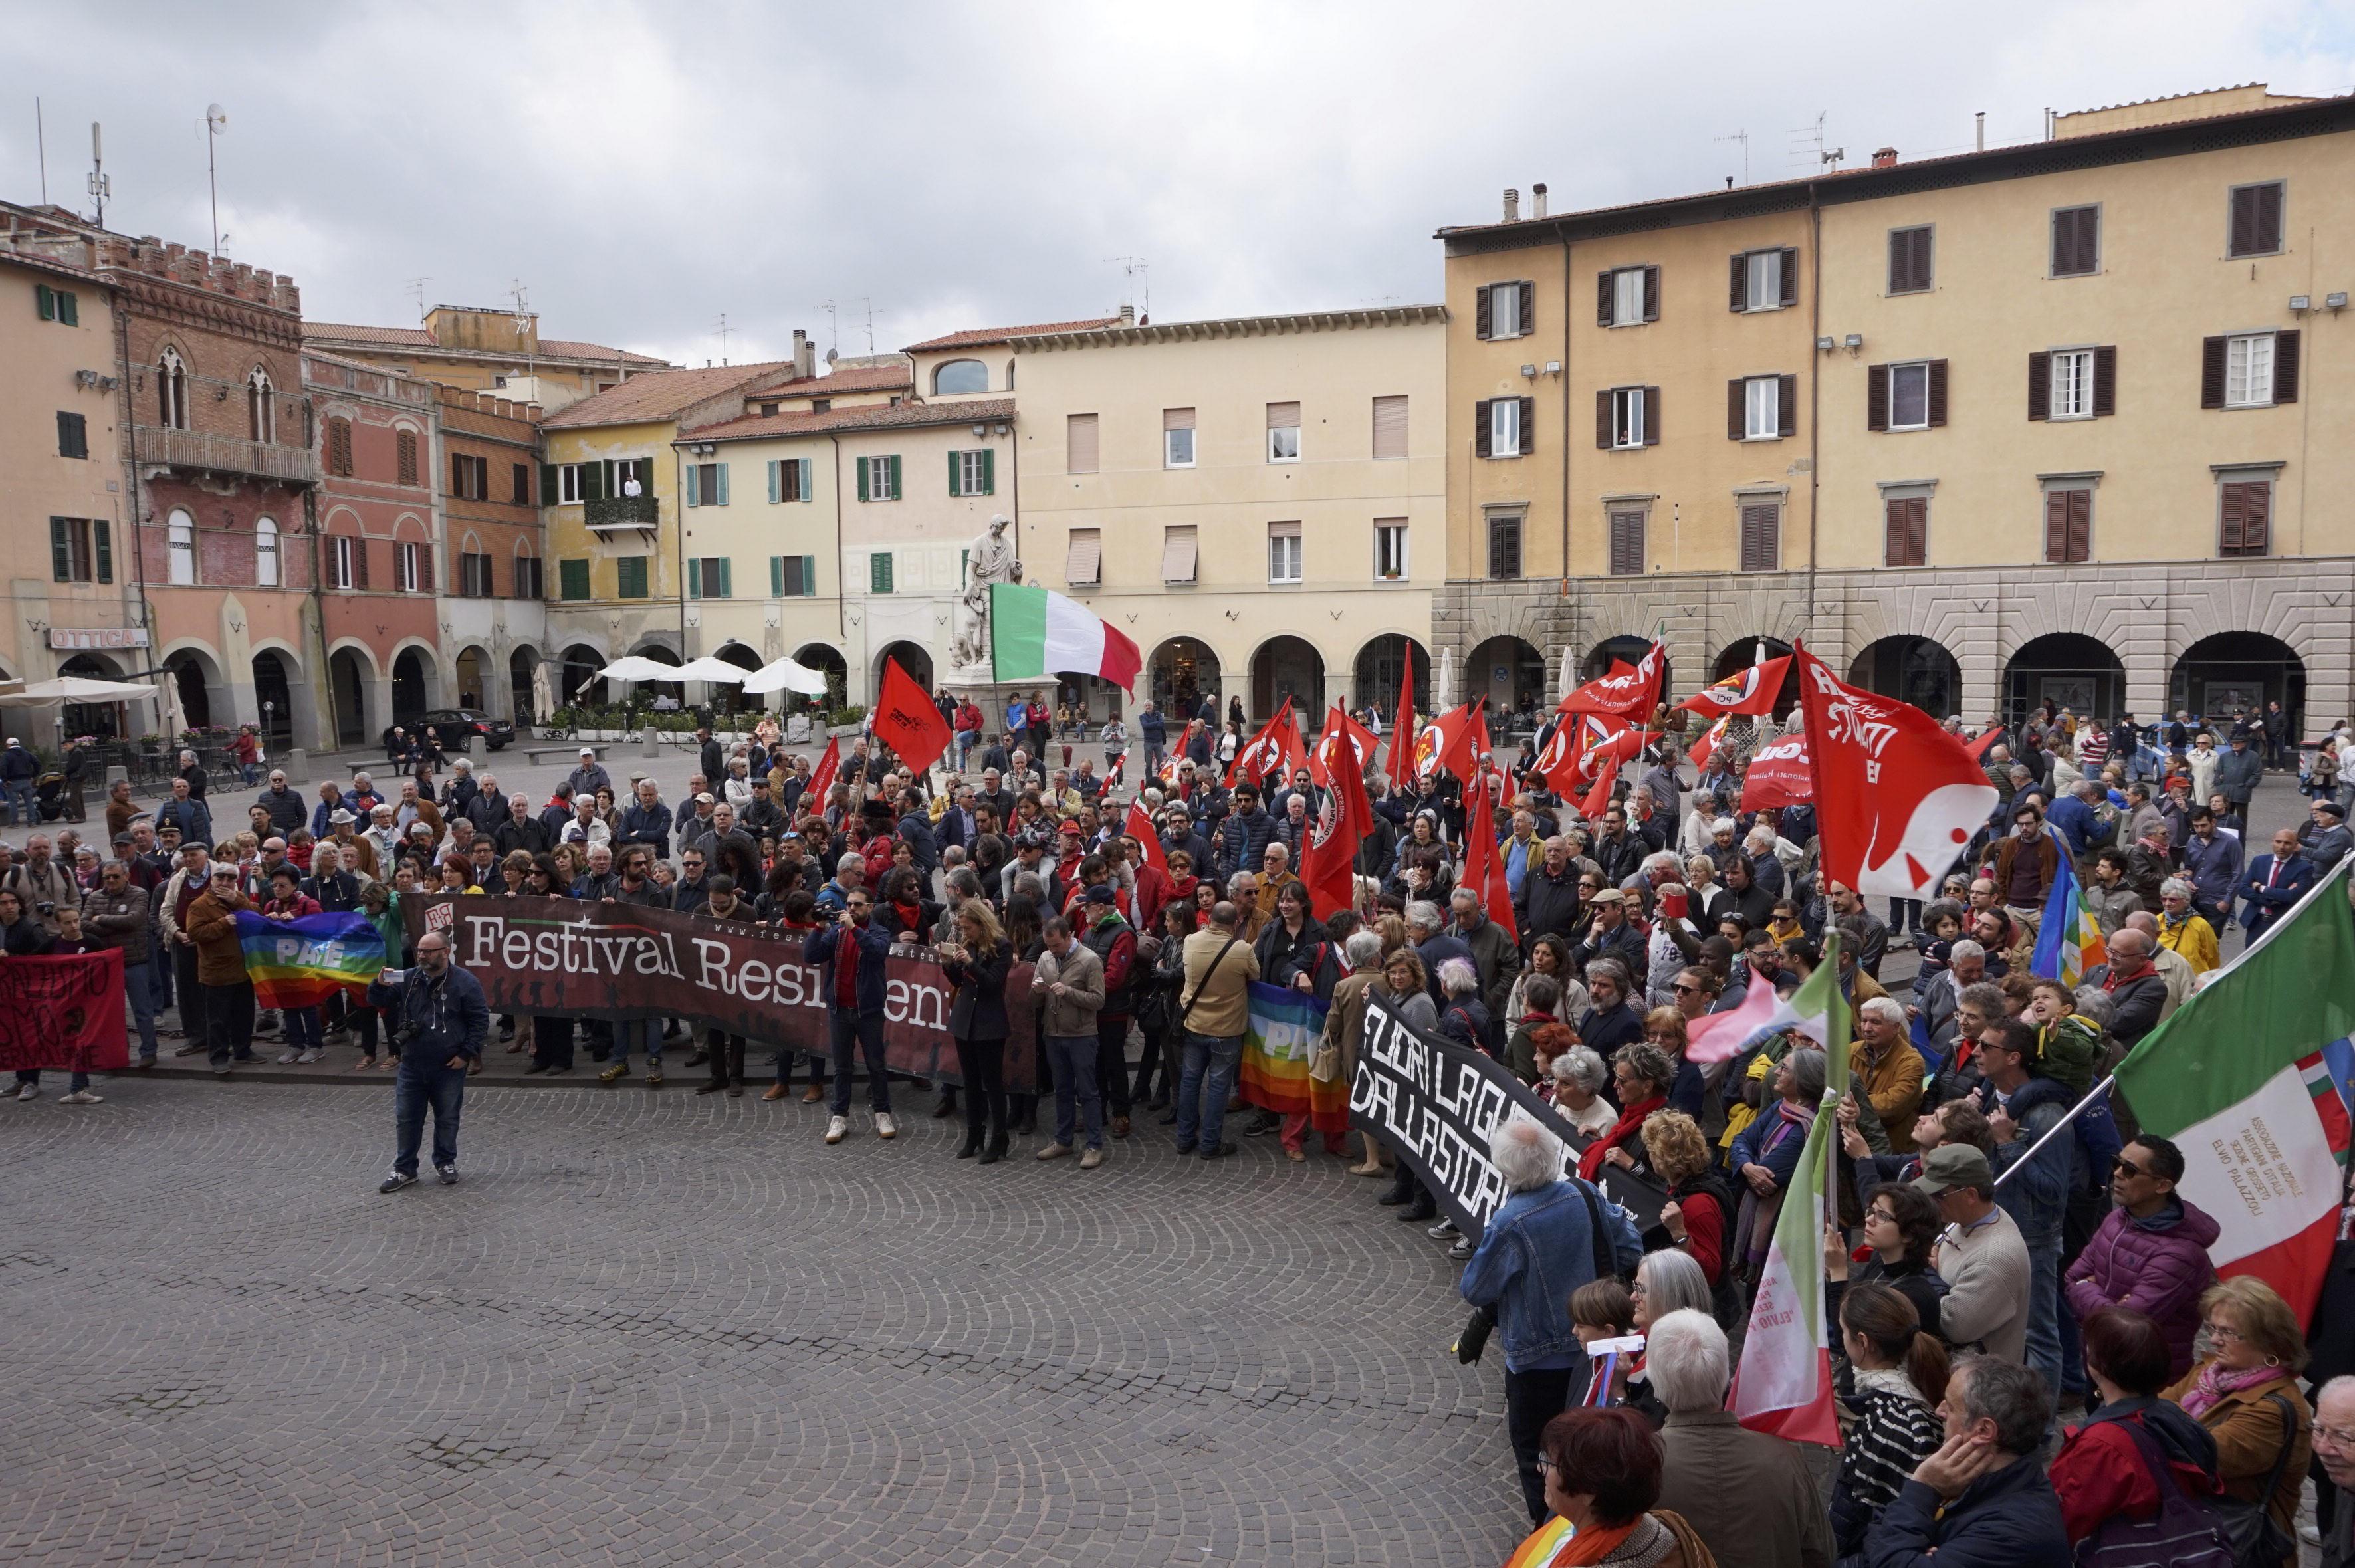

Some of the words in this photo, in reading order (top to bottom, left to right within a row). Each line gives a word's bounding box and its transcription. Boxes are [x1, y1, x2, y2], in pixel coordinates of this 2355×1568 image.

[53, 629, 134, 647] OTTICA
[465, 915, 685, 980] Festival
[691, 937, 951, 1031] Resien
[1264, 1020, 1308, 1060] PA
[1363, 1003, 1429, 1096] FUORI
[1433, 1121, 1510, 1228] STORI
[2211, 1139, 2233, 1165] ELVIO
[2227, 1168, 2264, 1217] PALAZZOLI
[2229, 1139, 2251, 1166] SEZIONE
[2245, 1167, 2271, 1201] GROSSETO
[2241, 1129, 2269, 1167] PARTIGIANI
[2263, 1168, 2286, 1198] D'ITALIA
[2251, 1117, 2283, 1161] ASSOCIAZIONE
[2276, 1163, 2304, 1198] NAZIONALE
